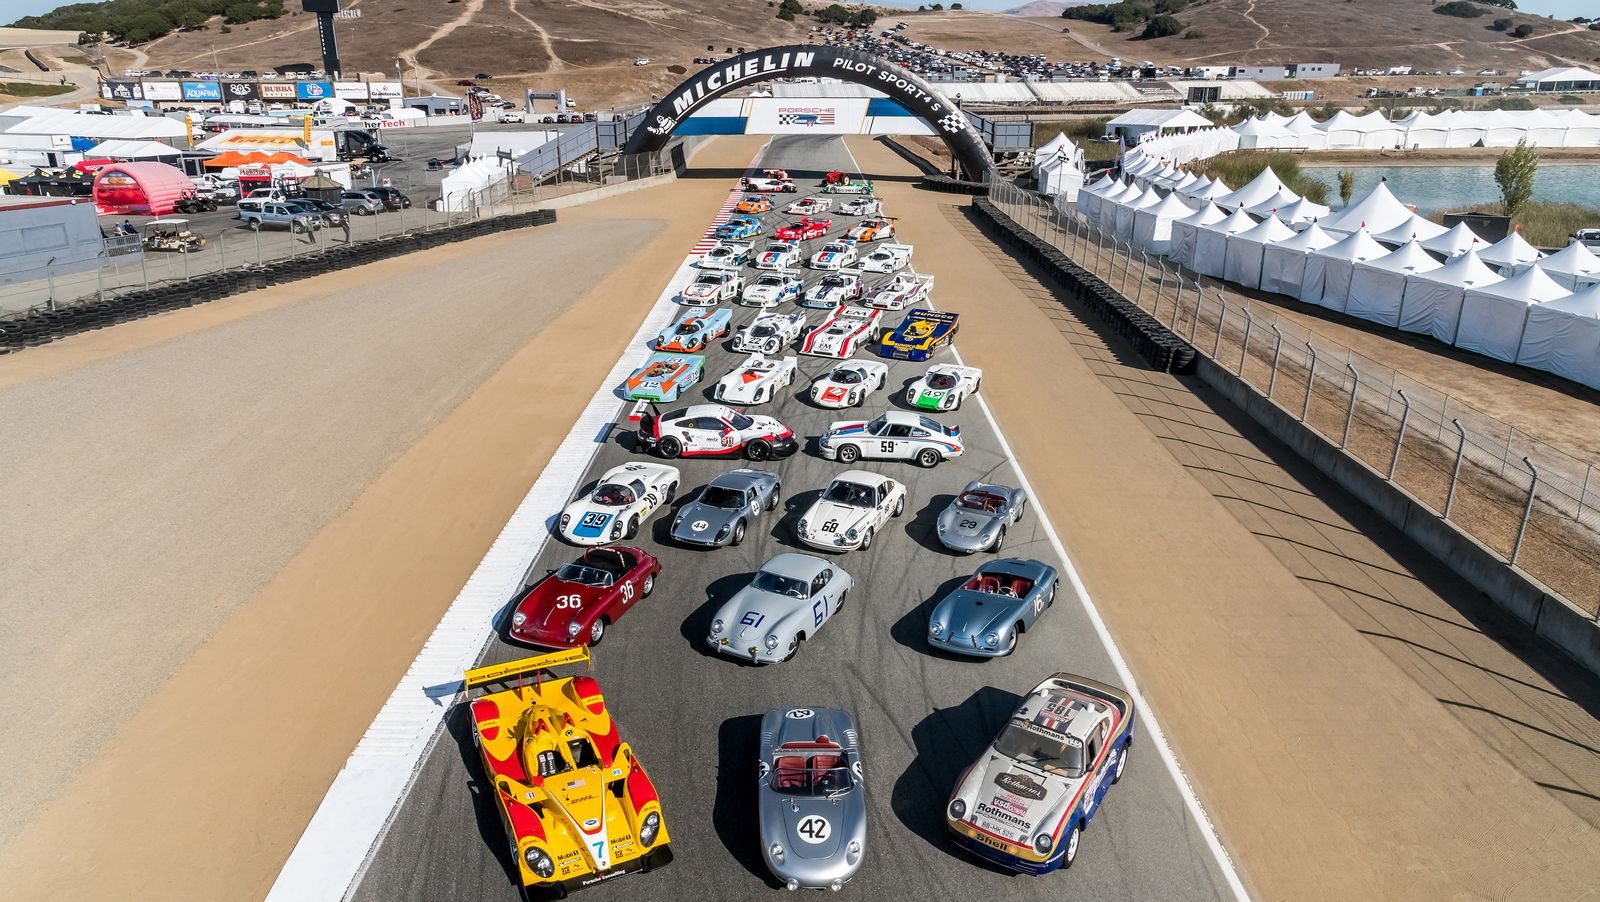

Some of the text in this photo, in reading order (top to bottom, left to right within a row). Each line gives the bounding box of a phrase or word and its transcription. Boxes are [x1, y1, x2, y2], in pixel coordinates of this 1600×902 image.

[673, 51, 815, 115] MICHELIN
[833, 57, 876, 75] PILOT
[878, 70, 925, 98] SPORT
[186, 89, 219, 98] AQUAFINA
[230, 83, 251, 93] 805
[364, 119, 405, 129] herTech
[912, 310, 954, 320] SUNOCO
[748, 337, 762, 345] 22
[721, 436, 734, 445] 911
[880, 440, 894, 453] 59
[643, 493, 659, 510] 39
[584, 513, 608, 526] 39
[692, 522, 707, 530] 44
[959, 519, 978, 529] 29
[821, 521, 839, 534] 68
[620, 580, 634, 604] 36
[556, 594, 582, 609] 36
[1033, 594, 1043, 617] 16
[739, 611, 766, 628] 61
[812, 595, 829, 629] 61
[792, 708, 811, 719] 42
[1044, 703, 1072, 718] 185
[1027, 723, 1066, 741] Rothmans
[1000, 776, 1042, 798] Rothmans
[977, 802, 1032, 830] Rothmans
[799, 818, 826, 839] 42
[610, 836, 626, 845] Mobil
[975, 832, 1009, 852] Shell
[557, 851, 574, 861] Mobil
[592, 841, 604, 859] 7
[582, 869, 626, 886] Porsche Consulting
